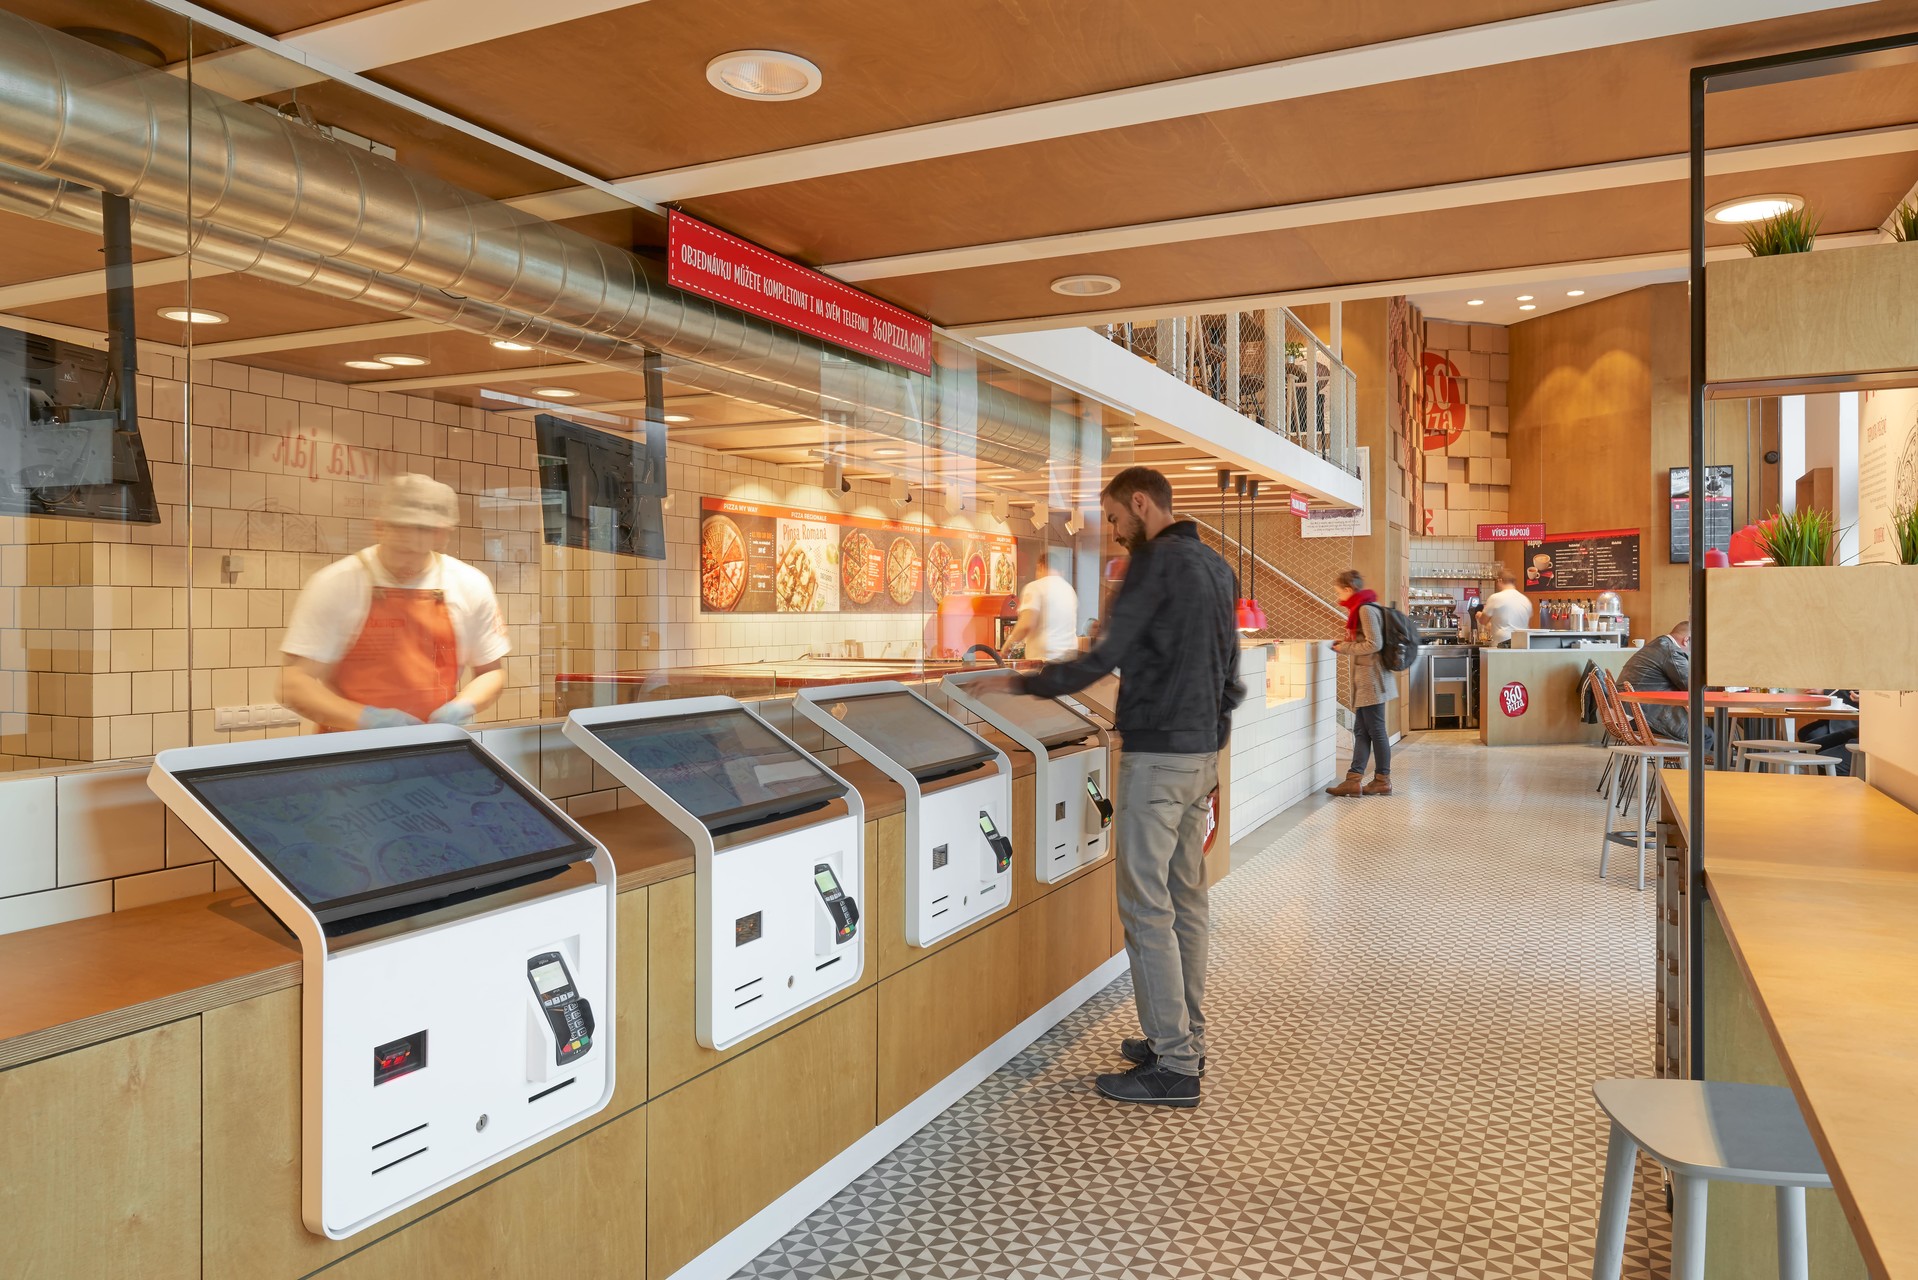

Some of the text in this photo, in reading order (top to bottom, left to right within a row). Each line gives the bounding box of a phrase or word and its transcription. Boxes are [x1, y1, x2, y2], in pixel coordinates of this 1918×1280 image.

[681, 244, 925, 359] OBJEDNÁVKU MŮŽETE KOMPLETOVAT I NA SVÉM TELEFONU 360PIZZA.COM
[723, 503, 739, 511] PIZZA
[739, 504, 747, 512] MY
[791, 511, 804, 519] PIZZA
[783, 524, 827, 541] Pinsa Romana
[1491, 526, 1530, 537] VÝDEJ NÁPOJŮ
[1503, 685, 1522, 706] 360
[1506, 699, 1525, 713] pizza
